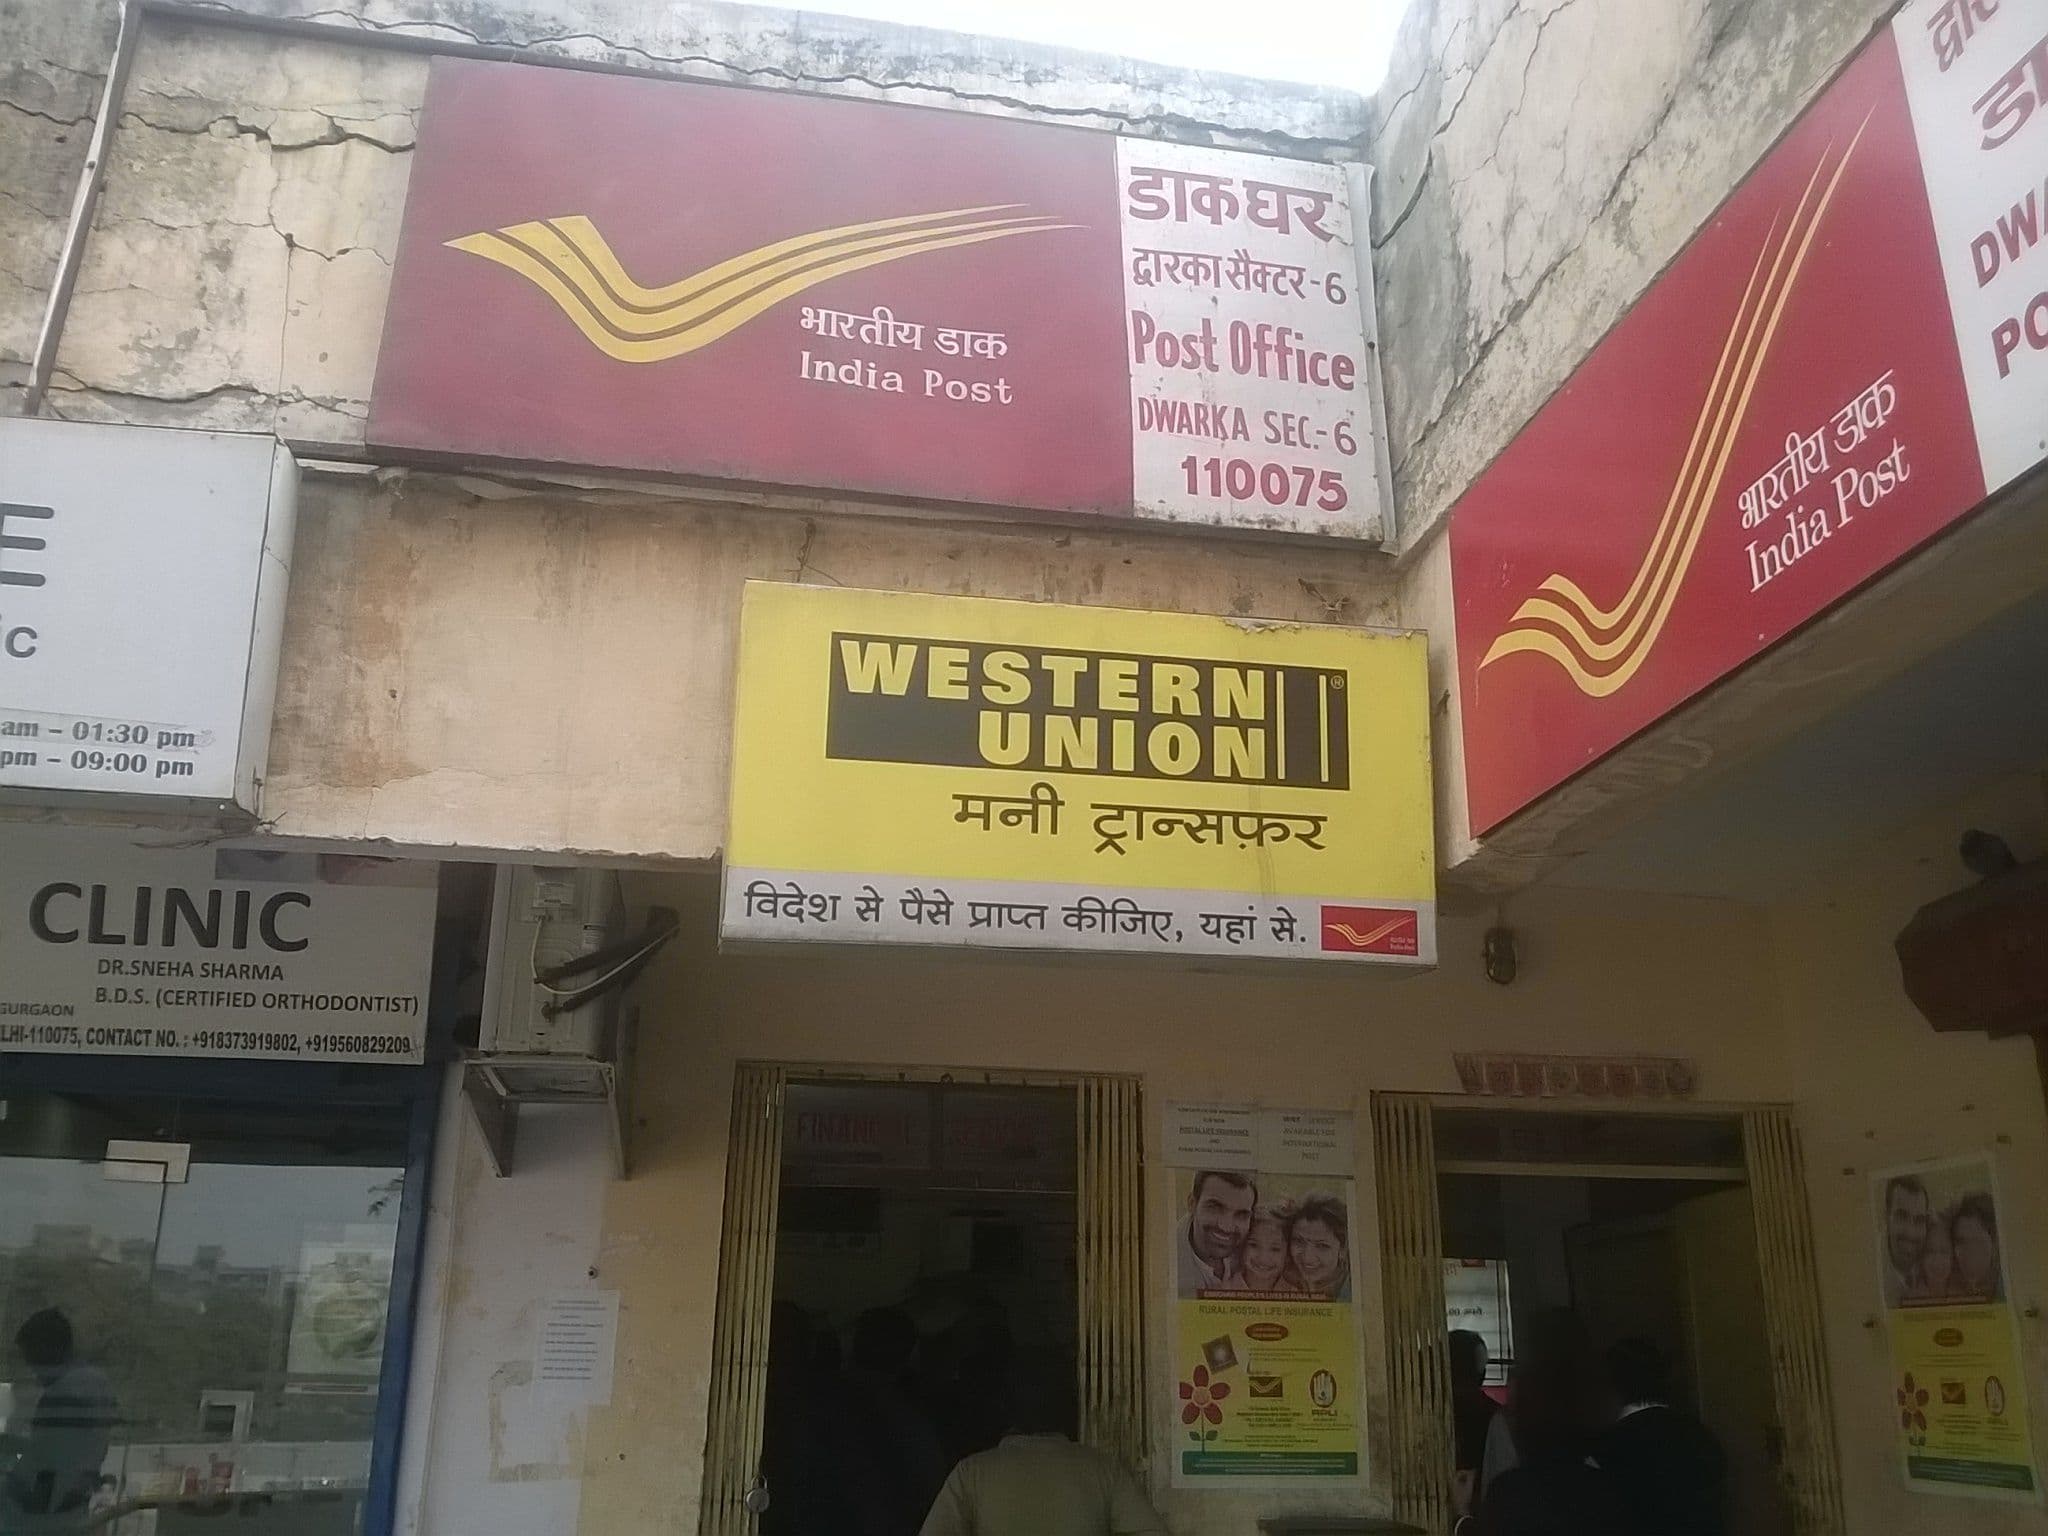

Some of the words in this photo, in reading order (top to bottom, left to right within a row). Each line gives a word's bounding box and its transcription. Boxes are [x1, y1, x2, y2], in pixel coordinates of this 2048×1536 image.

[1970, 175, 2048, 288] DW
[800, 306, 925, 350] भारतीय
[934, 327, 1008, 359] डाक
[1132, 310, 1219, 372] Post
[1229, 320, 1355, 390] Office
[800, 350, 904, 393] India
[923, 368, 1013, 405] Post
[1138, 397, 1249, 441] DWARKA
[1738, 432, 1830, 529] भारतीय
[1829, 369, 1896, 453] डाक
[1182, 456, 1347, 511] 110075
[1745, 505, 1832, 592] India
[1831, 437, 1910, 528] Post
[839, 639, 1265, 720] WESTERN
[0, 721, 38, 738] am
[72, 721, 148, 744] 01:30
[157, 730, 195, 749] pm
[977, 710, 1265, 780] UNION
[71, 750, 147, 773] 09:00
[155, 759, 193, 778] pm
[953, 783, 1065, 835] मनी
[1091, 802, 1328, 856] ट्रान्सफ़र
[29, 882, 311, 953] CLINIC
[744, 880, 841, 923] विदेश
[855, 885, 884, 924] से
[900, 888, 953, 926] पैसे
[967, 901, 1048, 931] प्राप्त
[1199, 906, 1260, 943] यहां
[1269, 907, 1307, 944] से.
[98, 958, 194, 978] DR.SNEHA
[199, 961, 284, 981] SHARMA
[95, 987, 150, 1006] B.D.S.
[156, 988, 256, 1010] (CERTIFIED
[262, 992, 419, 1016] ORTHODONTIST)
[86, 1028, 151, 1047] CONTACT
[1199, 1304, 1226, 1315] RURAL
[1230, 1305, 1261, 1316] POSTAL
[1264, 1306, 1282, 1317] LIFE
[1284, 1306, 1334, 1318] INSURANCE
